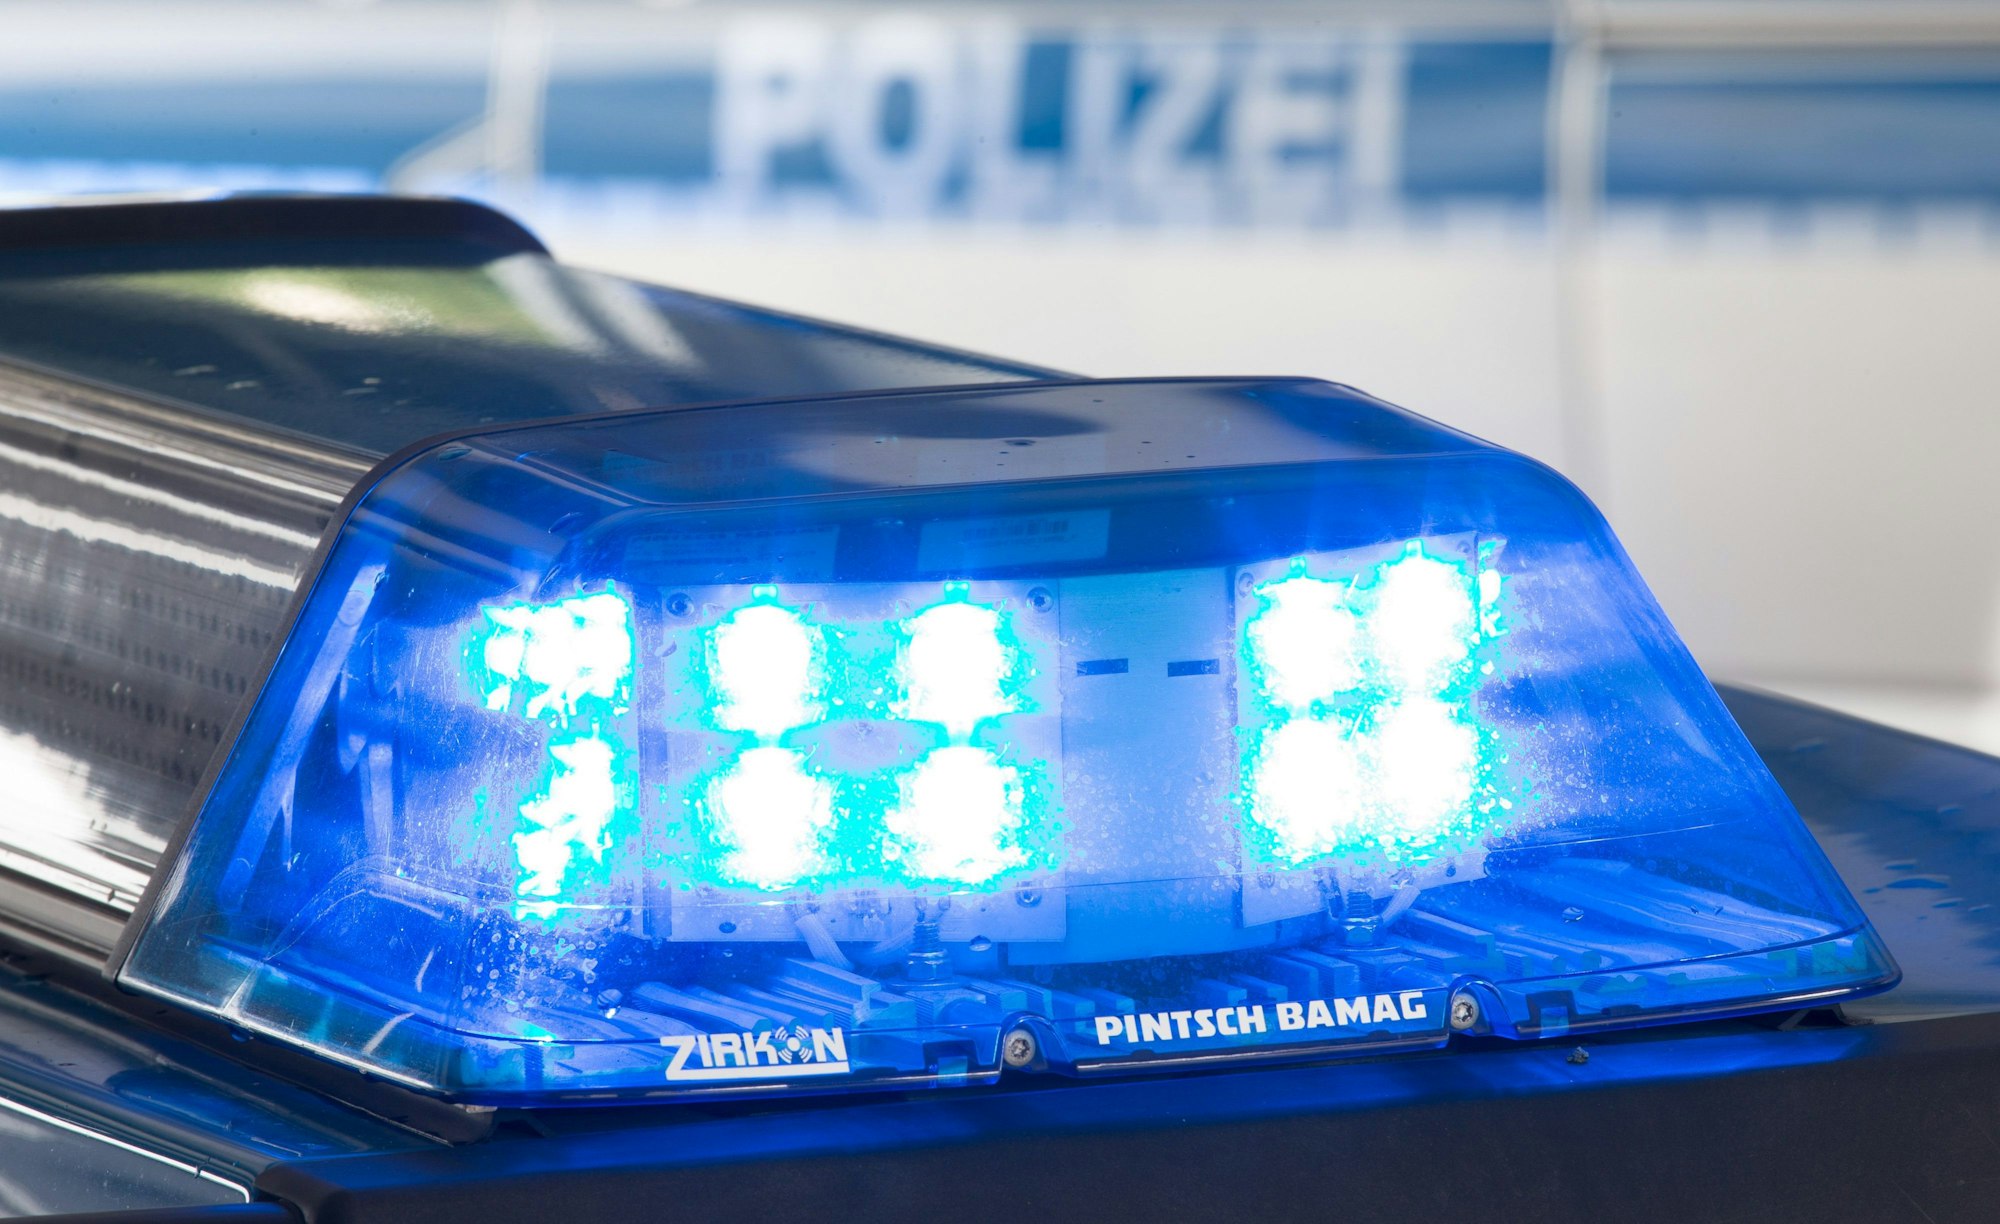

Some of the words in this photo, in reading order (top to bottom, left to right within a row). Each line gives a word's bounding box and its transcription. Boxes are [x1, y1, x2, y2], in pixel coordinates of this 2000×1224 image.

[715, 18, 1402, 220] POLIZEI
[1095, 1005, 1267, 1045] PINTSCH
[1276, 991, 1427, 1031] BAMAG
[660, 1026, 849, 1081] ZIRKON
